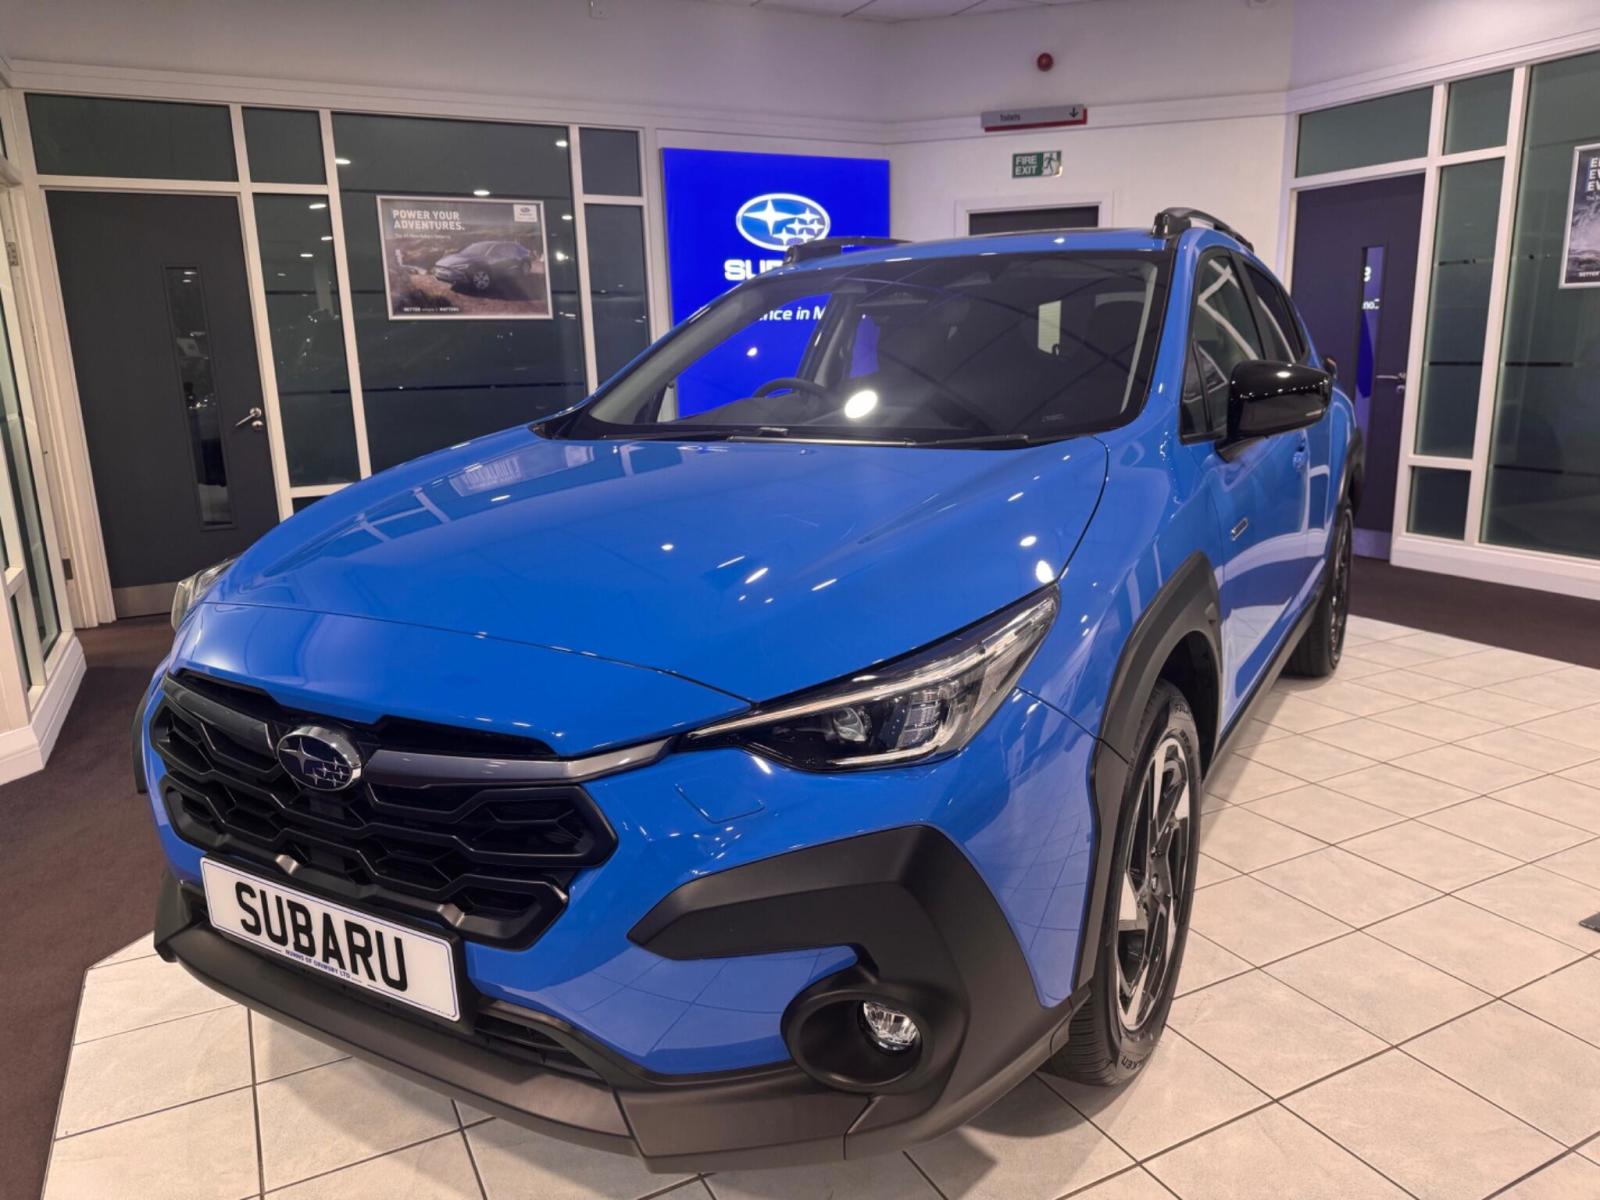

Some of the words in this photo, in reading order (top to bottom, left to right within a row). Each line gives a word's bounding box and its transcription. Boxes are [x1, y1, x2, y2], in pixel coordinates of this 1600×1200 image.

[1016, 156, 1037, 165] FIRE
[1015, 166, 1037, 176] EXIT
[393, 209, 430, 219] POWER
[432, 211, 459, 220] YOUR
[394, 220, 465, 230] ADVENTURES.
[796, 306, 810, 320] in
[235, 881, 408, 992] SUBARU
